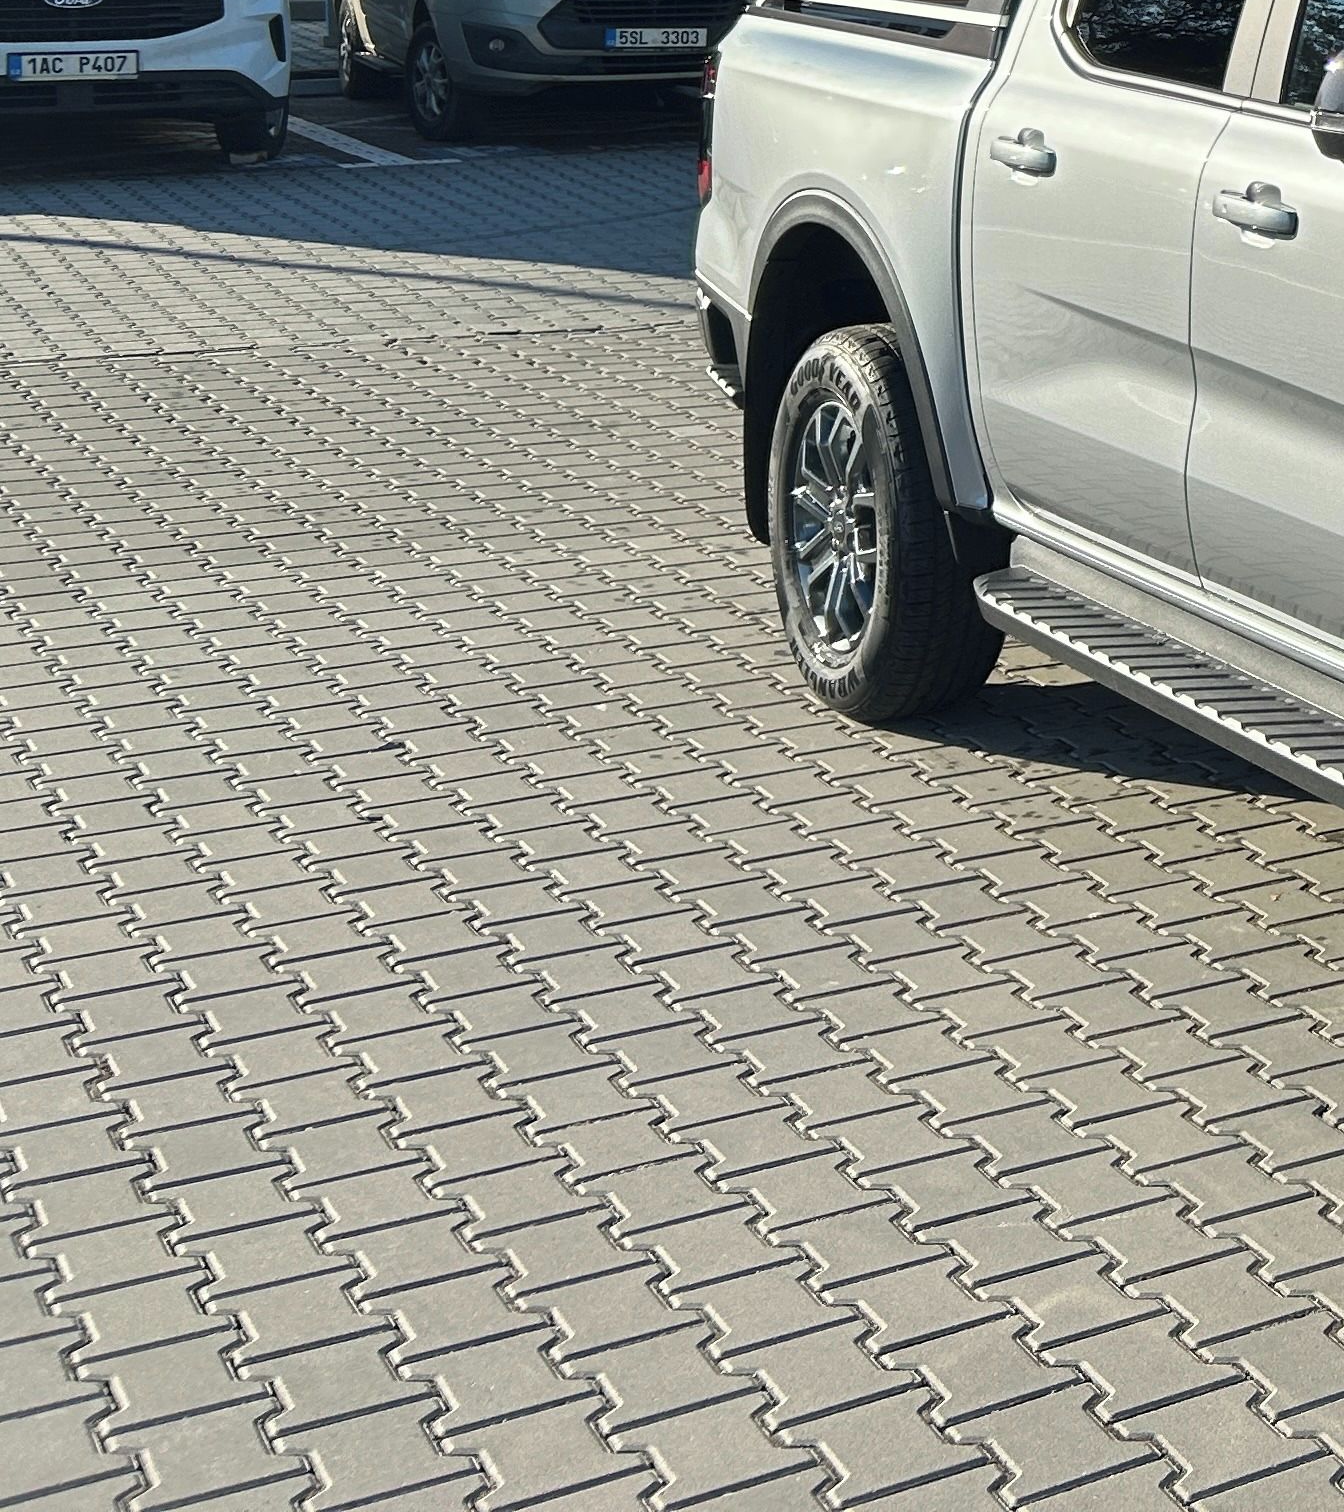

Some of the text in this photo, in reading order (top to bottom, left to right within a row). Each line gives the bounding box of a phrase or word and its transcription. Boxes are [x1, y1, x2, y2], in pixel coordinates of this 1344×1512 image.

[620, 30, 649, 46] 5SL
[661, 30, 700, 46] 3303
[28, 57, 64, 75] 1AC
[79, 55, 128, 74] P407
